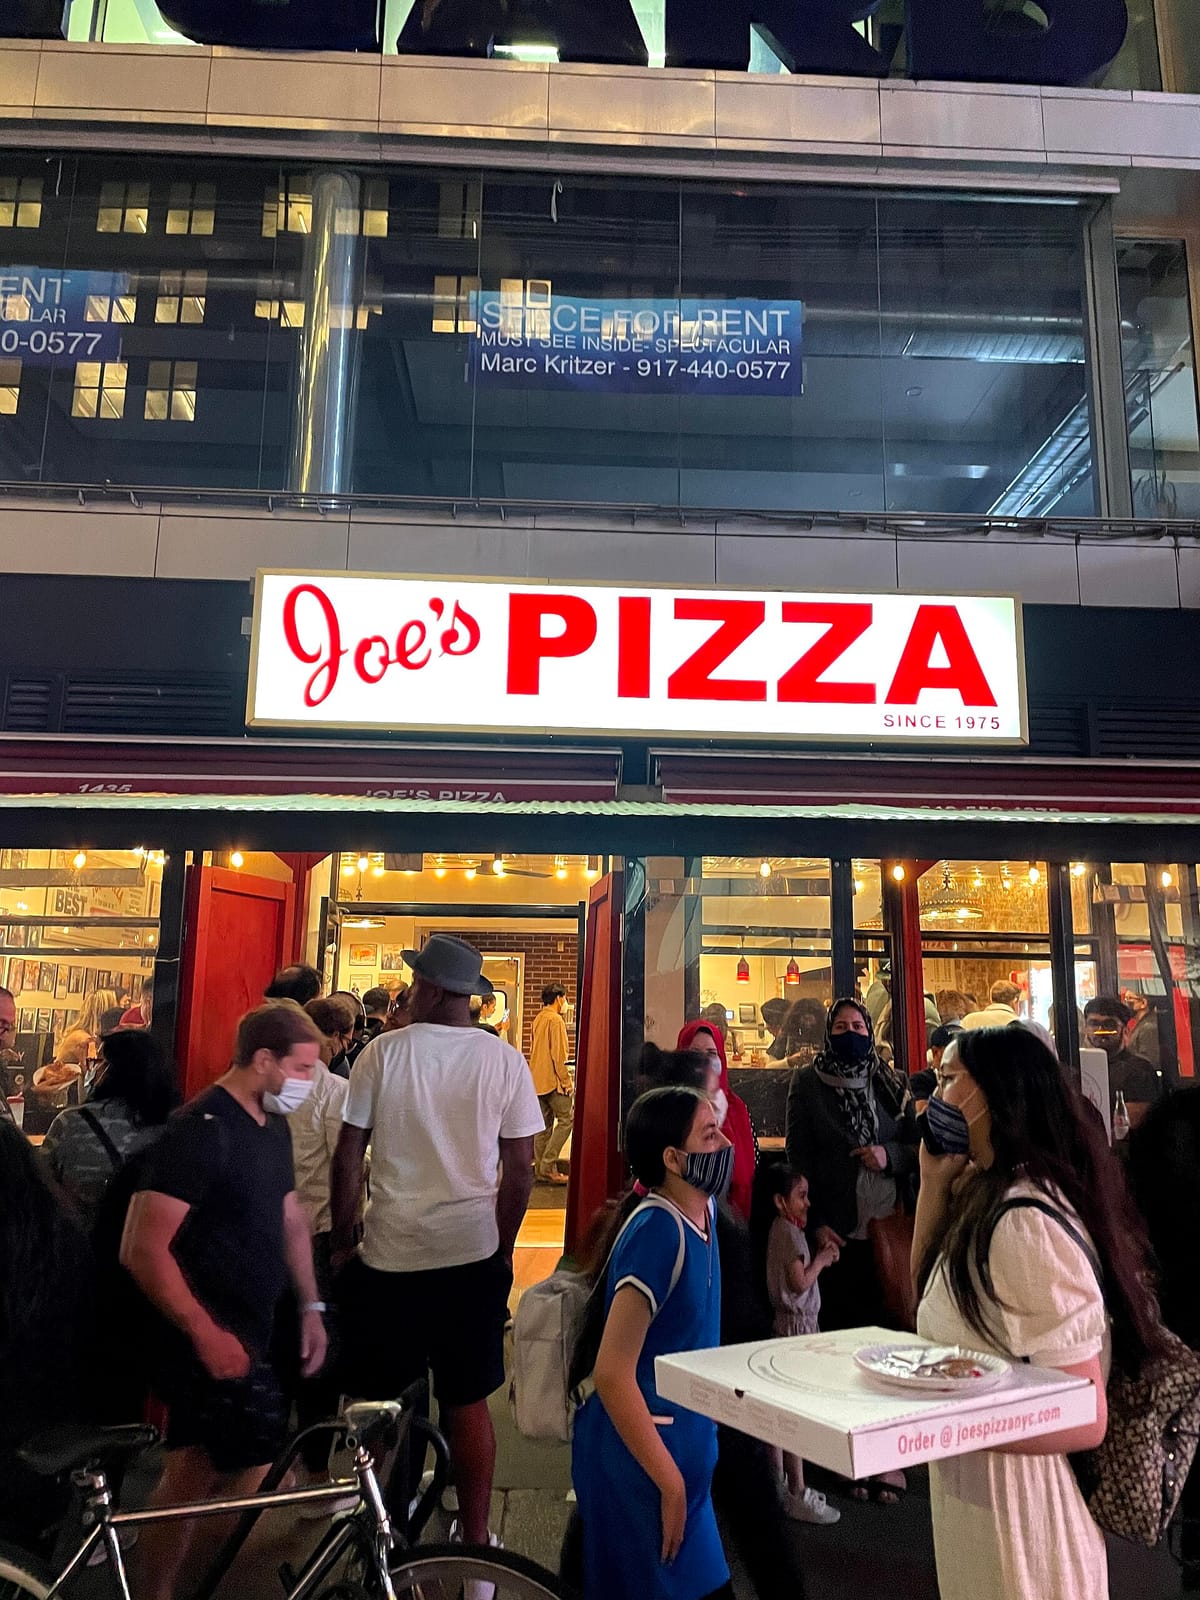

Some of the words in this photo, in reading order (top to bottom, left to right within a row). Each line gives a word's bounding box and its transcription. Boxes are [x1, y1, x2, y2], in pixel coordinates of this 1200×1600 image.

[697, 309, 790, 337] RENT
[481, 331, 532, 347] MUST
[540, 333, 577, 349] SEE
[655, 338, 791, 355] SPECTACULAR
[481, 352, 537, 373] Marc
[545, 354, 616, 375] Kritzer
[637, 359, 791, 379] 917-440-0577
[282, 583, 481, 707] Joe's
[506, 592, 998, 707] PIZZA
[883, 714, 946, 729] SINCE
[955, 716, 1000, 730] 1975
[55, 889, 88, 916] BEST
[898, 1431, 936, 1455] Order
[940, 1425, 953, 1448] @
[956, 1406, 1061, 1446] joespizzanyc.com
